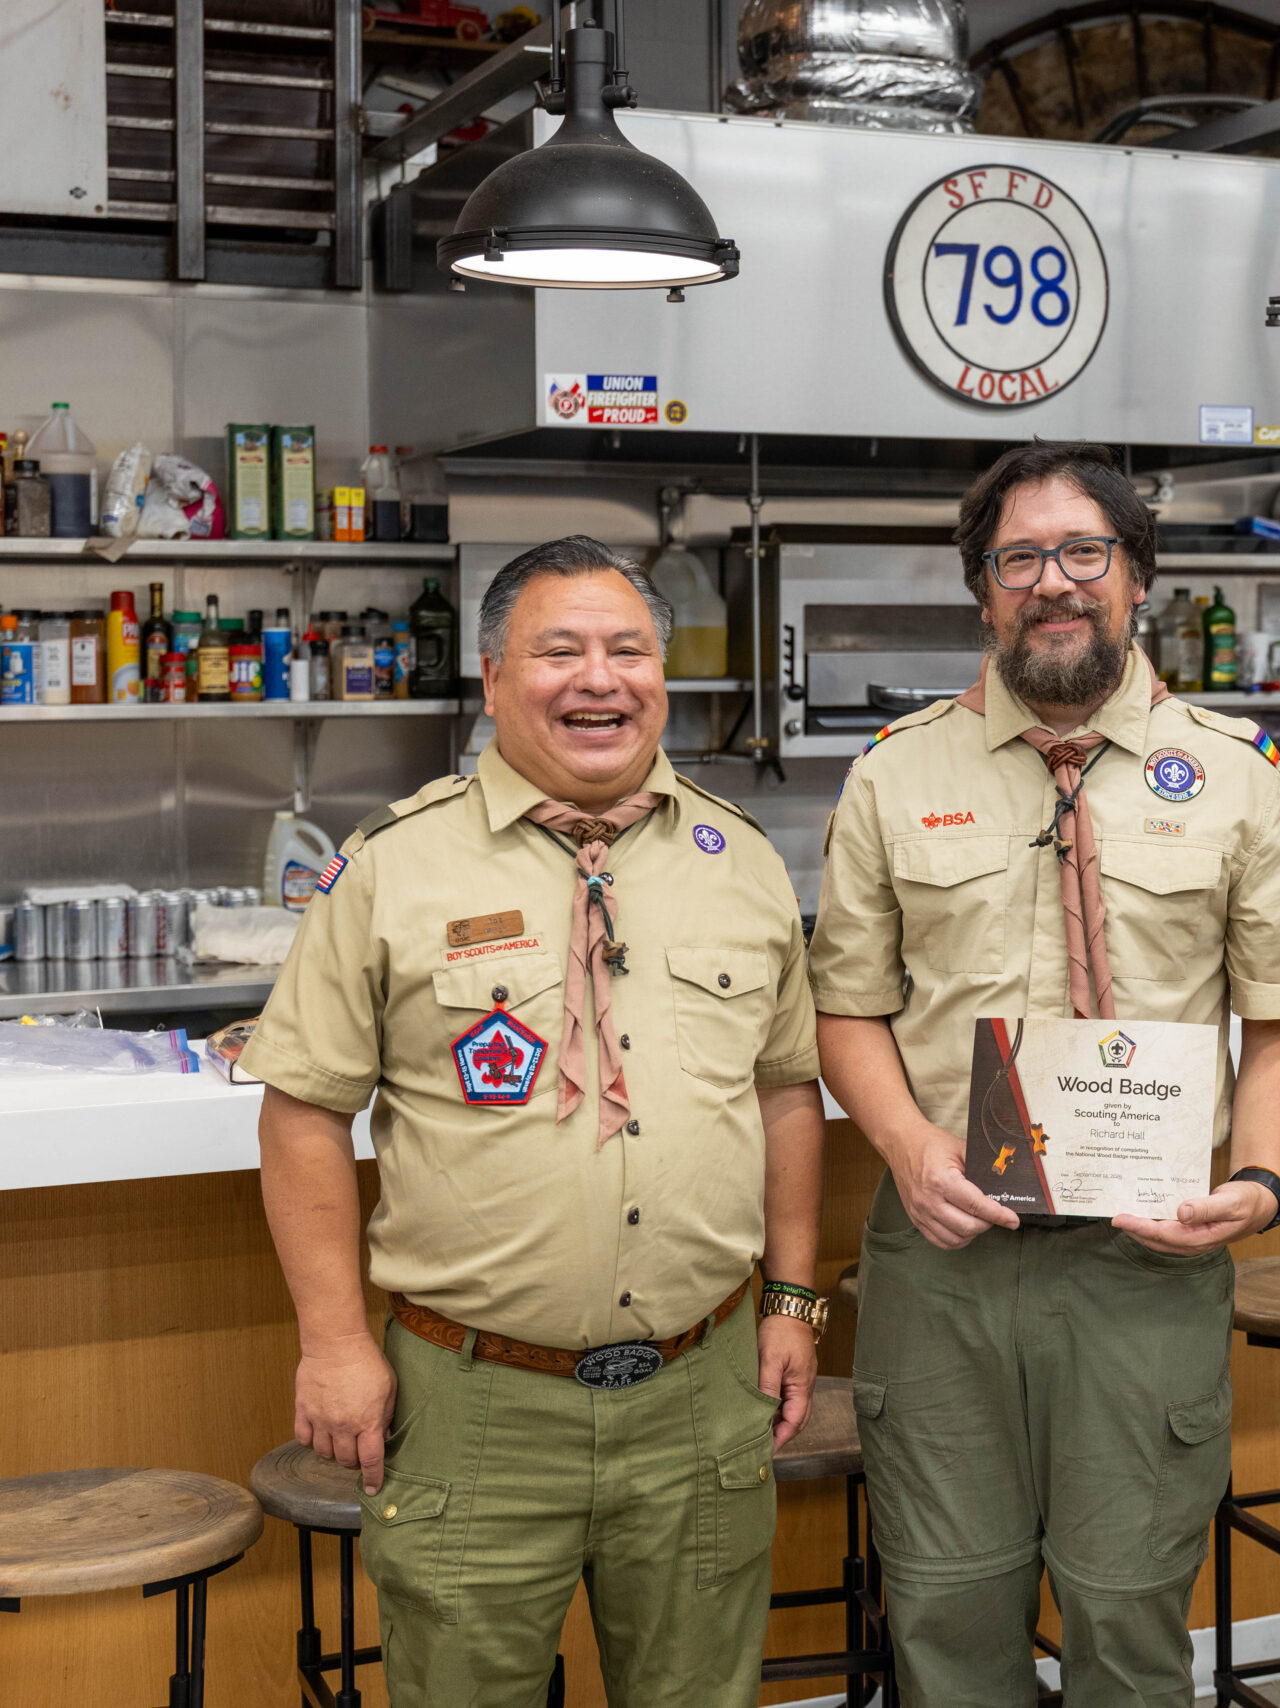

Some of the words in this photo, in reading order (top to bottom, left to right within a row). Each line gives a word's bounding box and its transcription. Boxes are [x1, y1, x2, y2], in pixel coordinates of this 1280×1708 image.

[933, 243, 1071, 328] 798
[602, 376, 645, 391] UNION
[955, 365, 1060, 403] LOCAL
[587, 391, 657, 407] FIREFIGHTER
[602, 407, 647, 423] PROUD
[943, 811, 976, 827] BSA
[446, 952, 464, 962] BOY
[464, 944, 497, 959] SCOUTS
[503, 938, 540, 951] AMERICA
[1057, 1076, 1113, 1095] Wood
[1119, 1078, 1182, 1101] Badge
[1103, 1102, 1122, 1110] given
[1123, 1102, 1132, 1111] by
[1074, 1108, 1118, 1121] Scouting
[1119, 1111, 1161, 1122] America
[1090, 1128, 1125, 1140] Richard
[1127, 1130, 1146, 1141] Hall
[1009, 1194, 1036, 1202] America
[584, 1351, 620, 1366] WOOD
[623, 1349, 657, 1361] BADGE
[602, 1379, 633, 1388] STAFF
